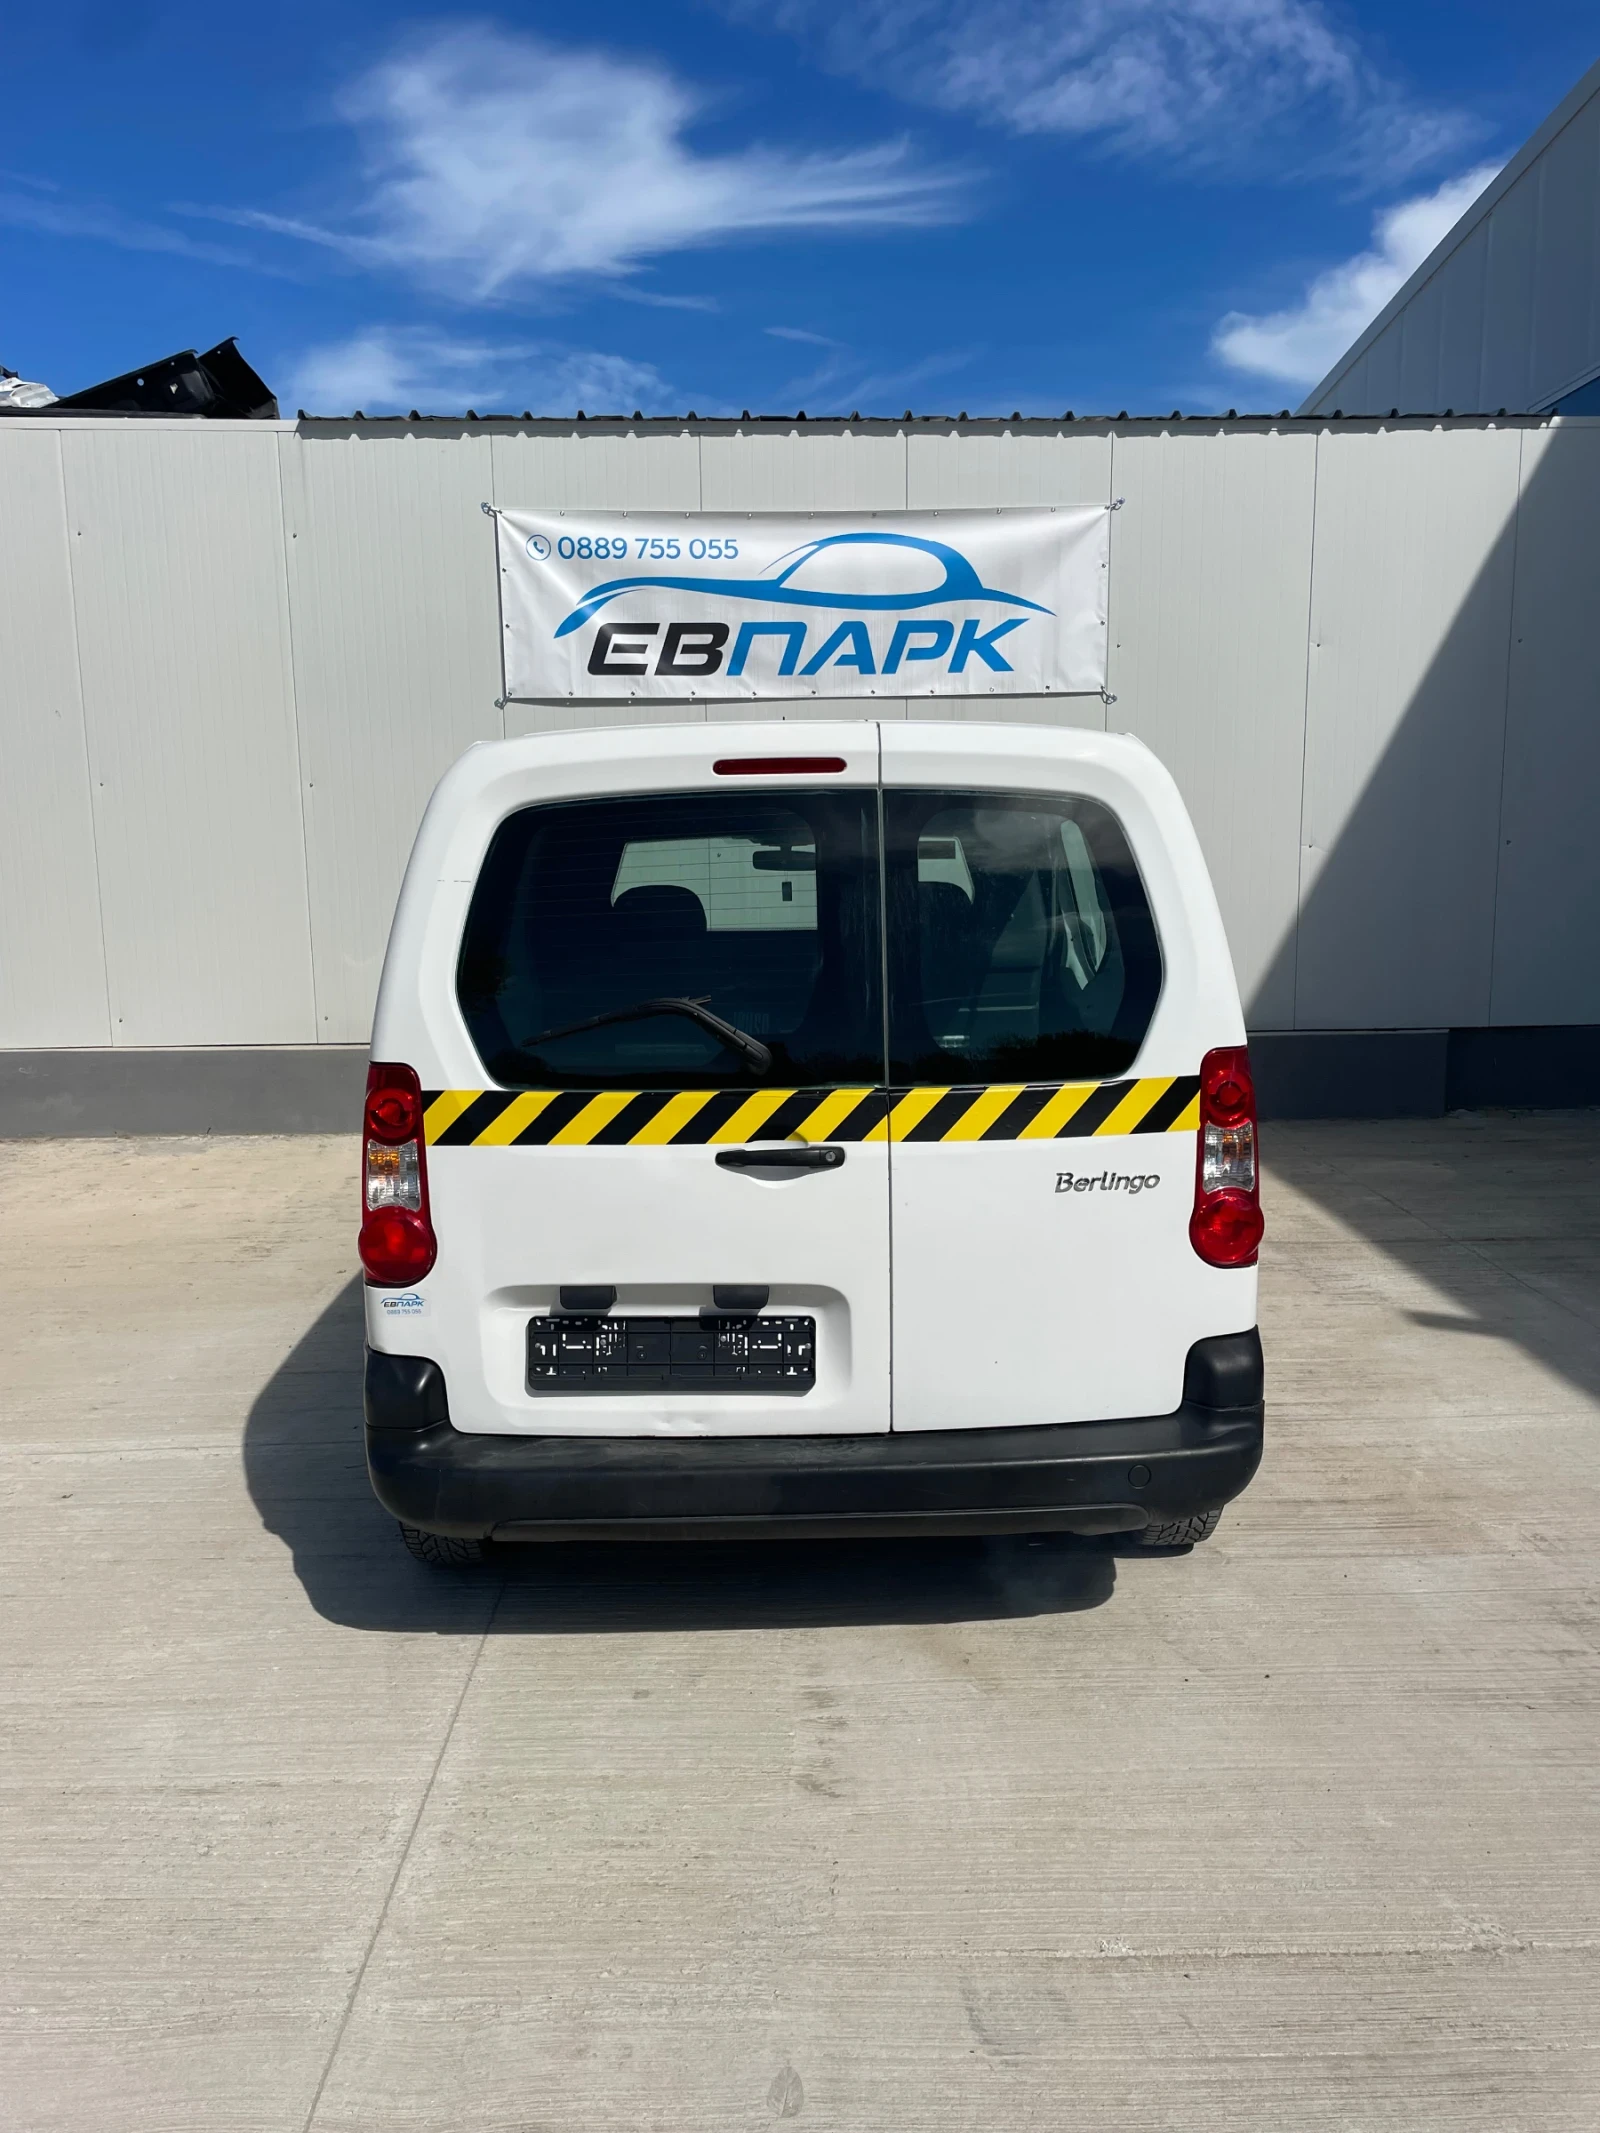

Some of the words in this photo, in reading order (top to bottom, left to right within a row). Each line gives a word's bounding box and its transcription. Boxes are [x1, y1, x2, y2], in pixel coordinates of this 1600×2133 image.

[557, 536, 628, 560] 0889
[635, 537, 682, 560] 755
[689, 536, 739, 560] 055
[587, 617, 1031, 677] ЕВПАРК
[1054, 1170, 1161, 1195] Berlingo
[383, 1300, 425, 1308] ЕВПАРК
